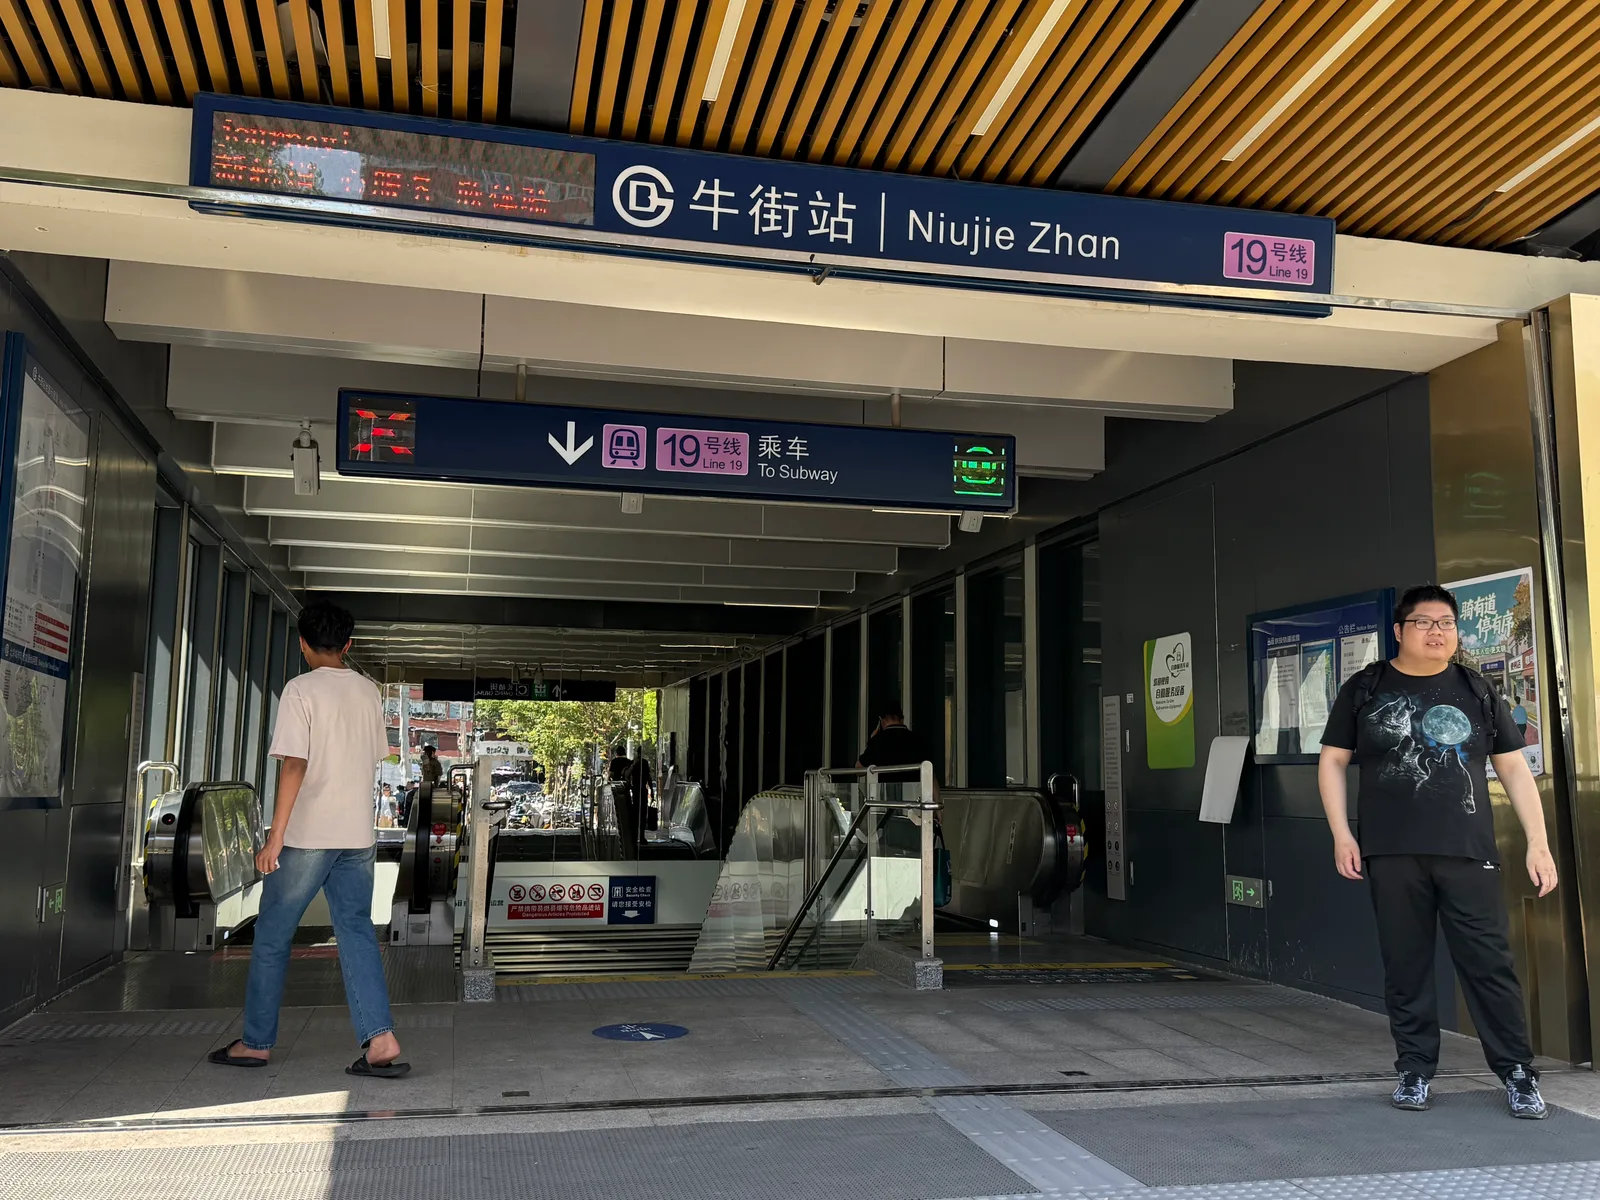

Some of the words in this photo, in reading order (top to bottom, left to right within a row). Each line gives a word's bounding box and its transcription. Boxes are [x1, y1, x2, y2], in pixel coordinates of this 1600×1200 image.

[689, 177, 857, 244] 牛街站
[908, 209, 1015, 255] Niujie
[1027, 221, 1121, 262] Zhan
[1231, 238, 1267, 275] 19
[1269, 266, 1291, 278] Line
[1296, 268, 1308, 279] 19
[663, 433, 700, 468] 19
[758, 435, 809, 461] 乘车
[703, 458, 725, 470] Line
[729, 460, 743, 471] 19
[757, 463, 776, 478] To
[779, 465, 838, 485] Subway
[1460, 592, 1497, 620] 骑有道
[1475, 610, 1515, 644] 停有序
